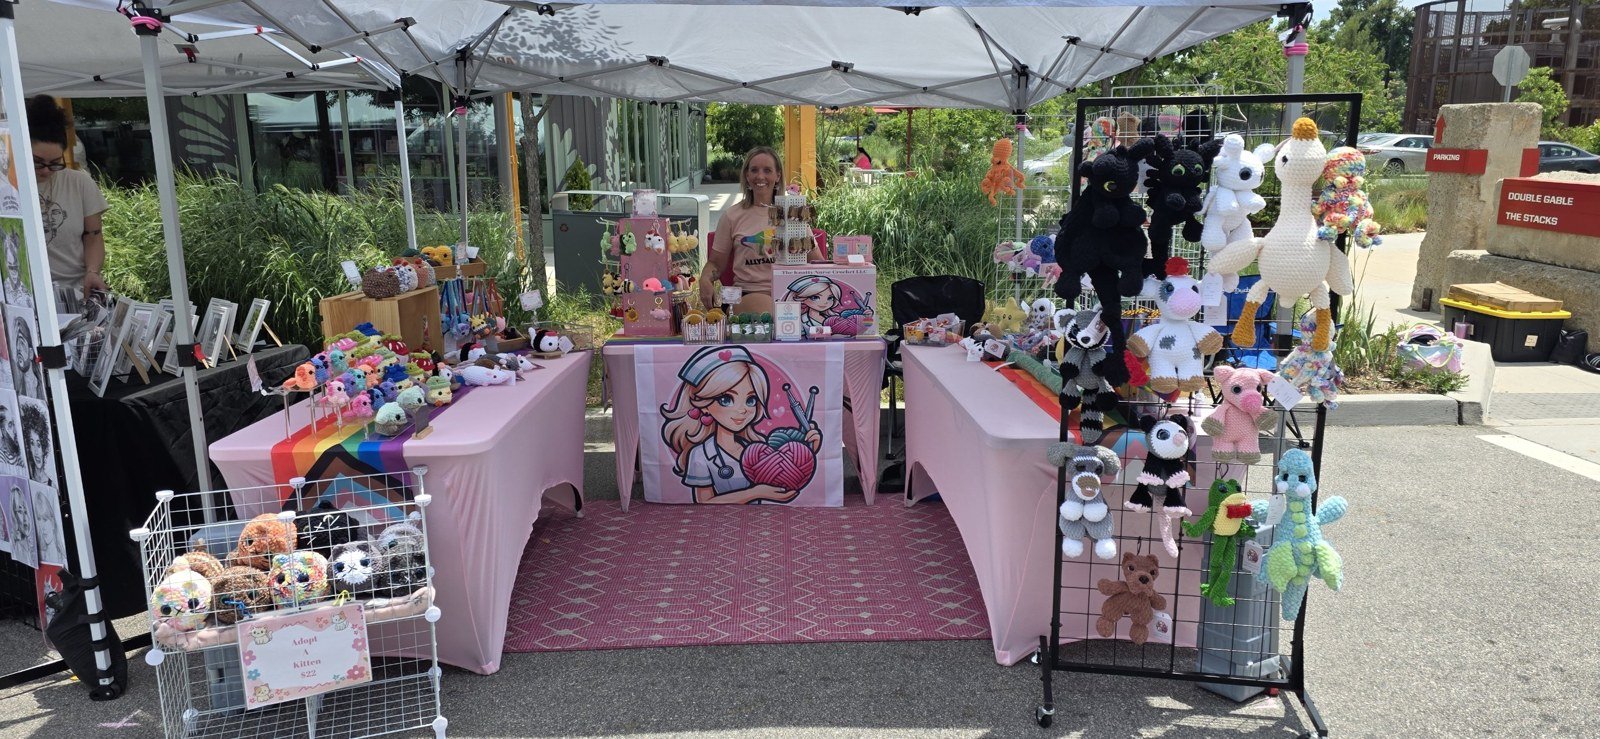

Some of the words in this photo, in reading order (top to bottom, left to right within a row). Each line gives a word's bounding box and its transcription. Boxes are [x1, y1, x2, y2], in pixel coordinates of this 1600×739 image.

[1433, 153, 1460, 161] PARKING
[1508, 192, 1542, 203] DOUBLE
[1543, 194, 1573, 206] GABLE
[1505, 211, 1521, 221] THE
[1523, 213, 1558, 226] STACKS
[292, 636, 318, 646] Adopt
[293, 659, 321, 669] Kitten
[301, 670, 317, 678] $22
